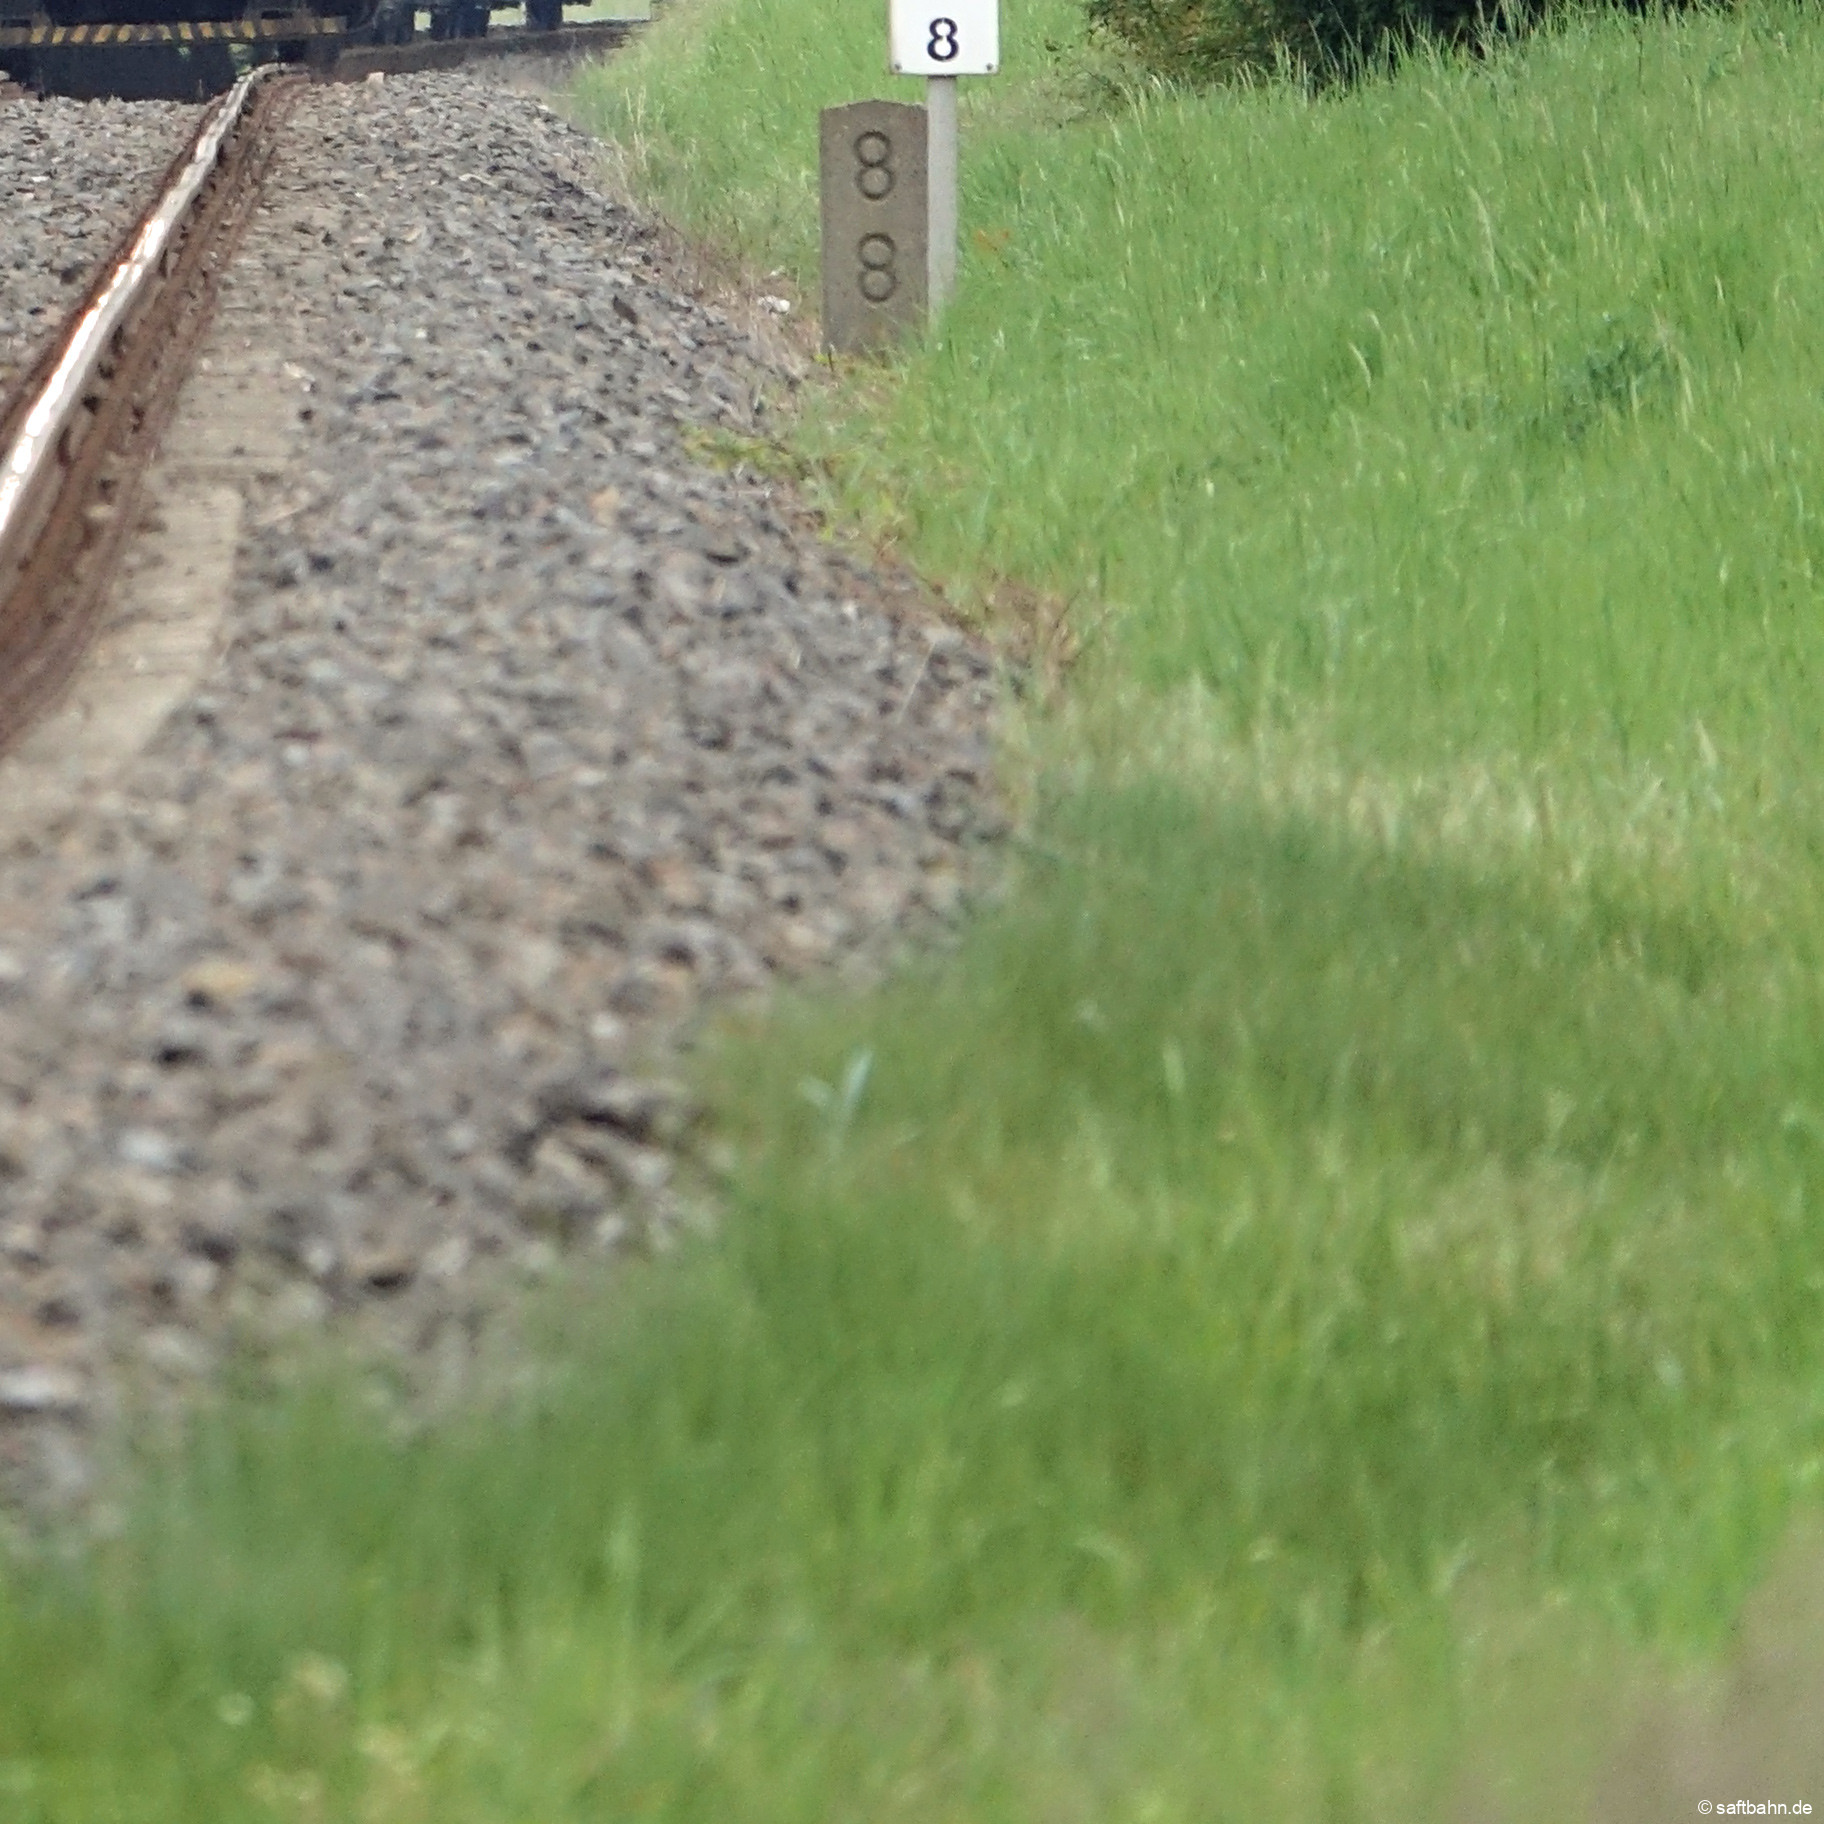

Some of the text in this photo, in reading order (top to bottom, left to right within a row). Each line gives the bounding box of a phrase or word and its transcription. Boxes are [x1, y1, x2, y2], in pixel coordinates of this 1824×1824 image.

[927, 17, 959, 62] 8
[853, 130, 895, 201] 8
[857, 231, 898, 303] 8
